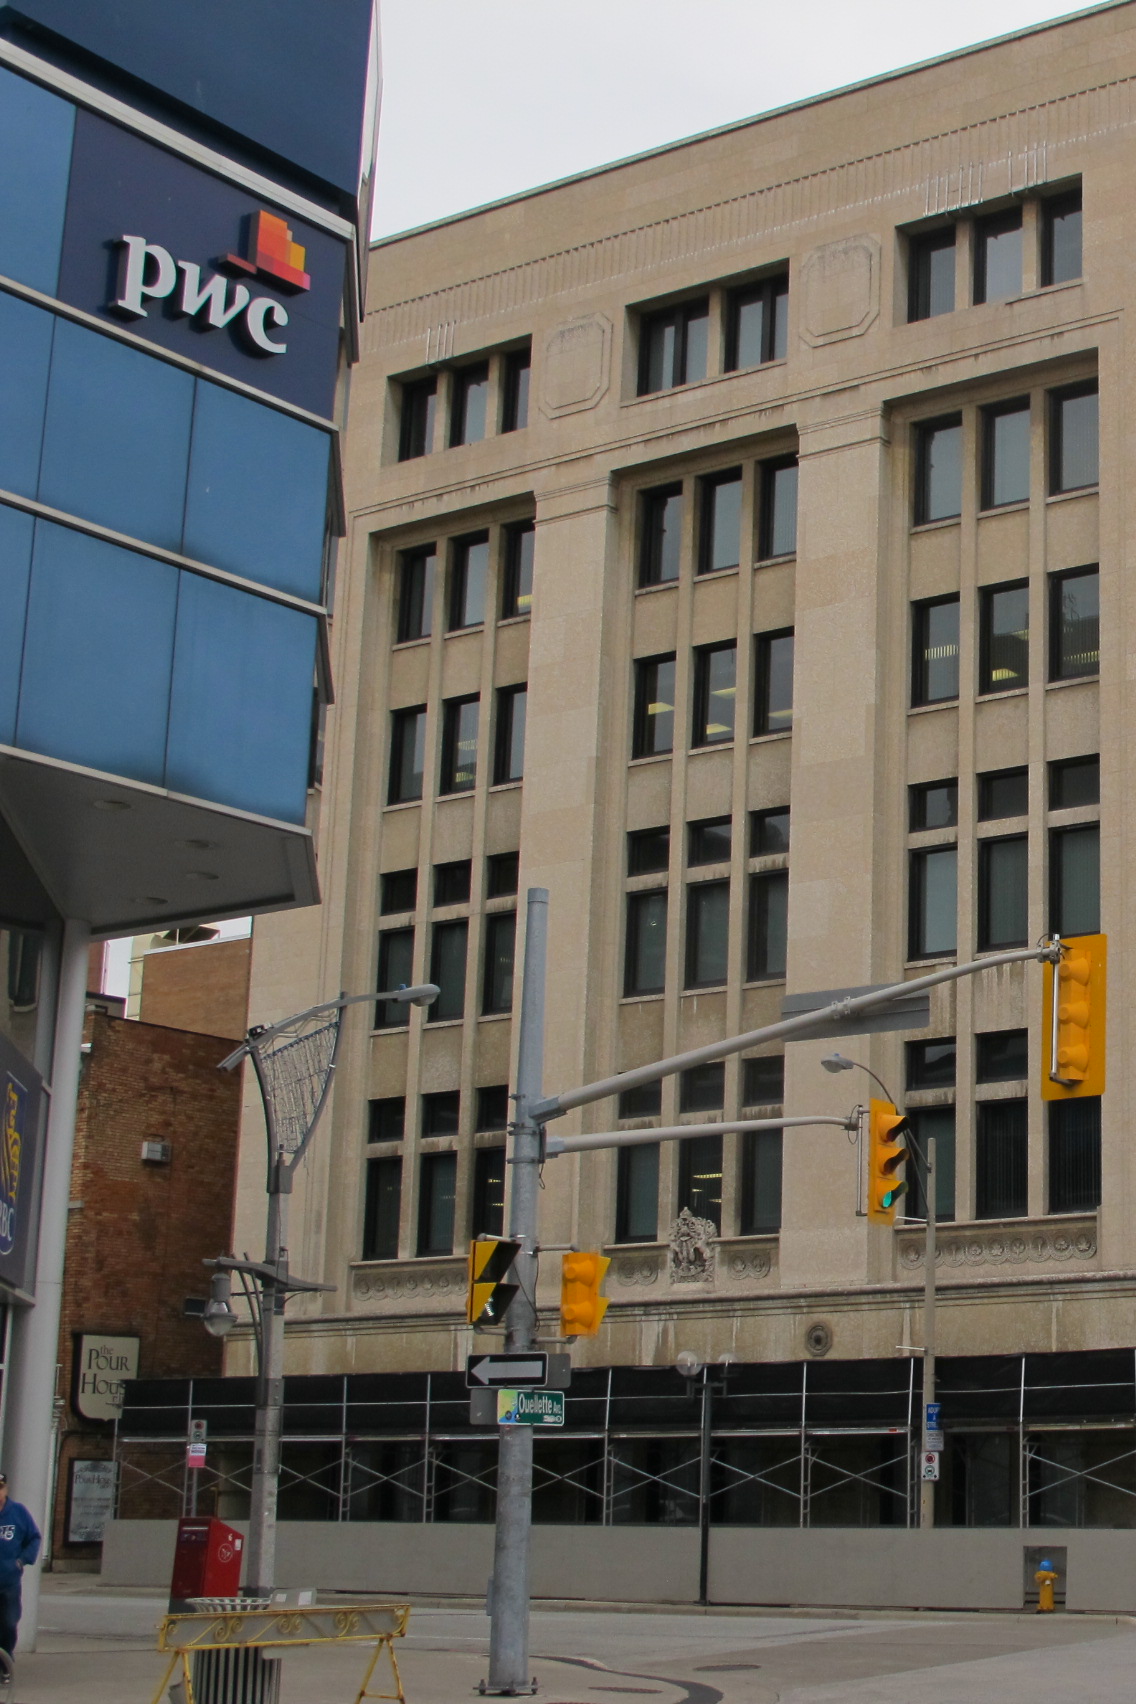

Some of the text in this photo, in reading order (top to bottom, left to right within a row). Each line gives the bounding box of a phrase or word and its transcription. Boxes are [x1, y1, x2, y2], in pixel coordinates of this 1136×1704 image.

[117, 234, 289, 354] pwc
[100, 1345, 114, 1355] the
[81, 1373, 125, 1395] HOU
[519, 1393, 552, 1414] Ouellette
